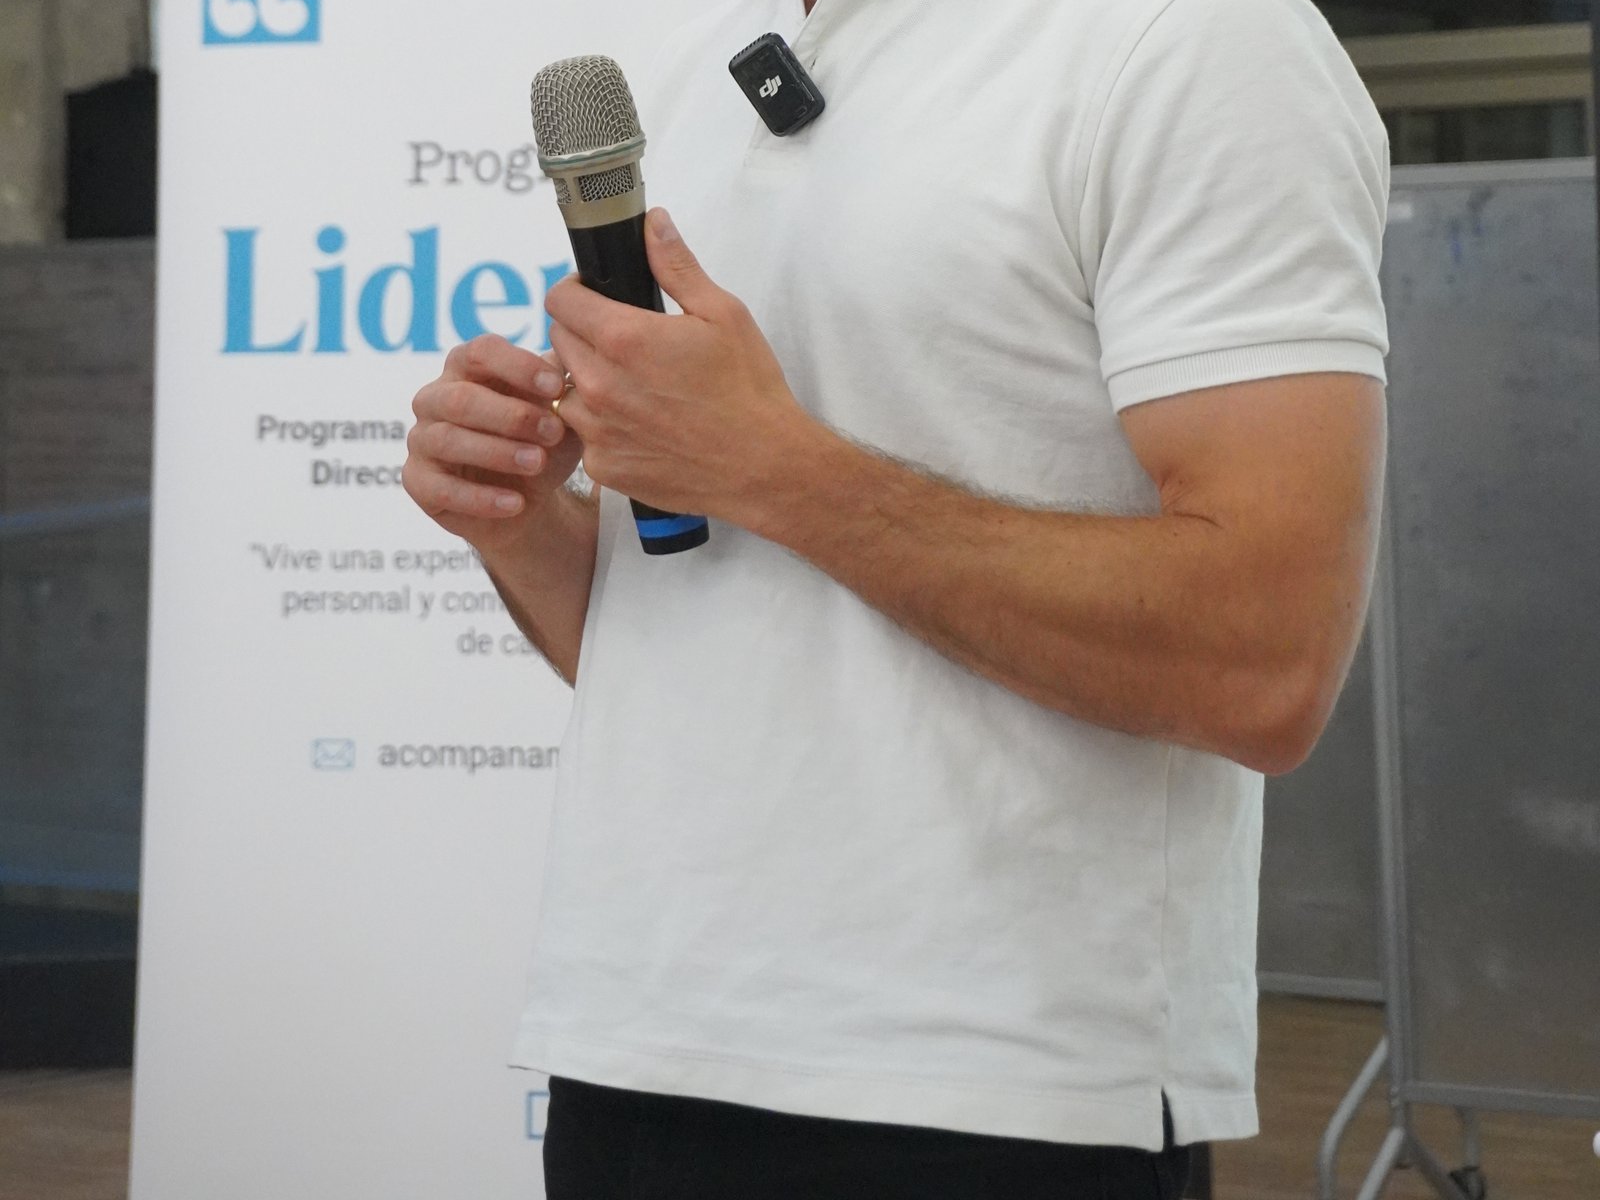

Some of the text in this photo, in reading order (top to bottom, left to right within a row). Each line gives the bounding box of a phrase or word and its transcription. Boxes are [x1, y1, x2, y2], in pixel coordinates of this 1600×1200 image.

[408, 140, 550, 194] Prog
[256, 413, 405, 448] Programa
[328, 549, 385, 572] una
[281, 585, 410, 619] personal
[418, 590, 435, 619] y
[456, 625, 494, 656] de
